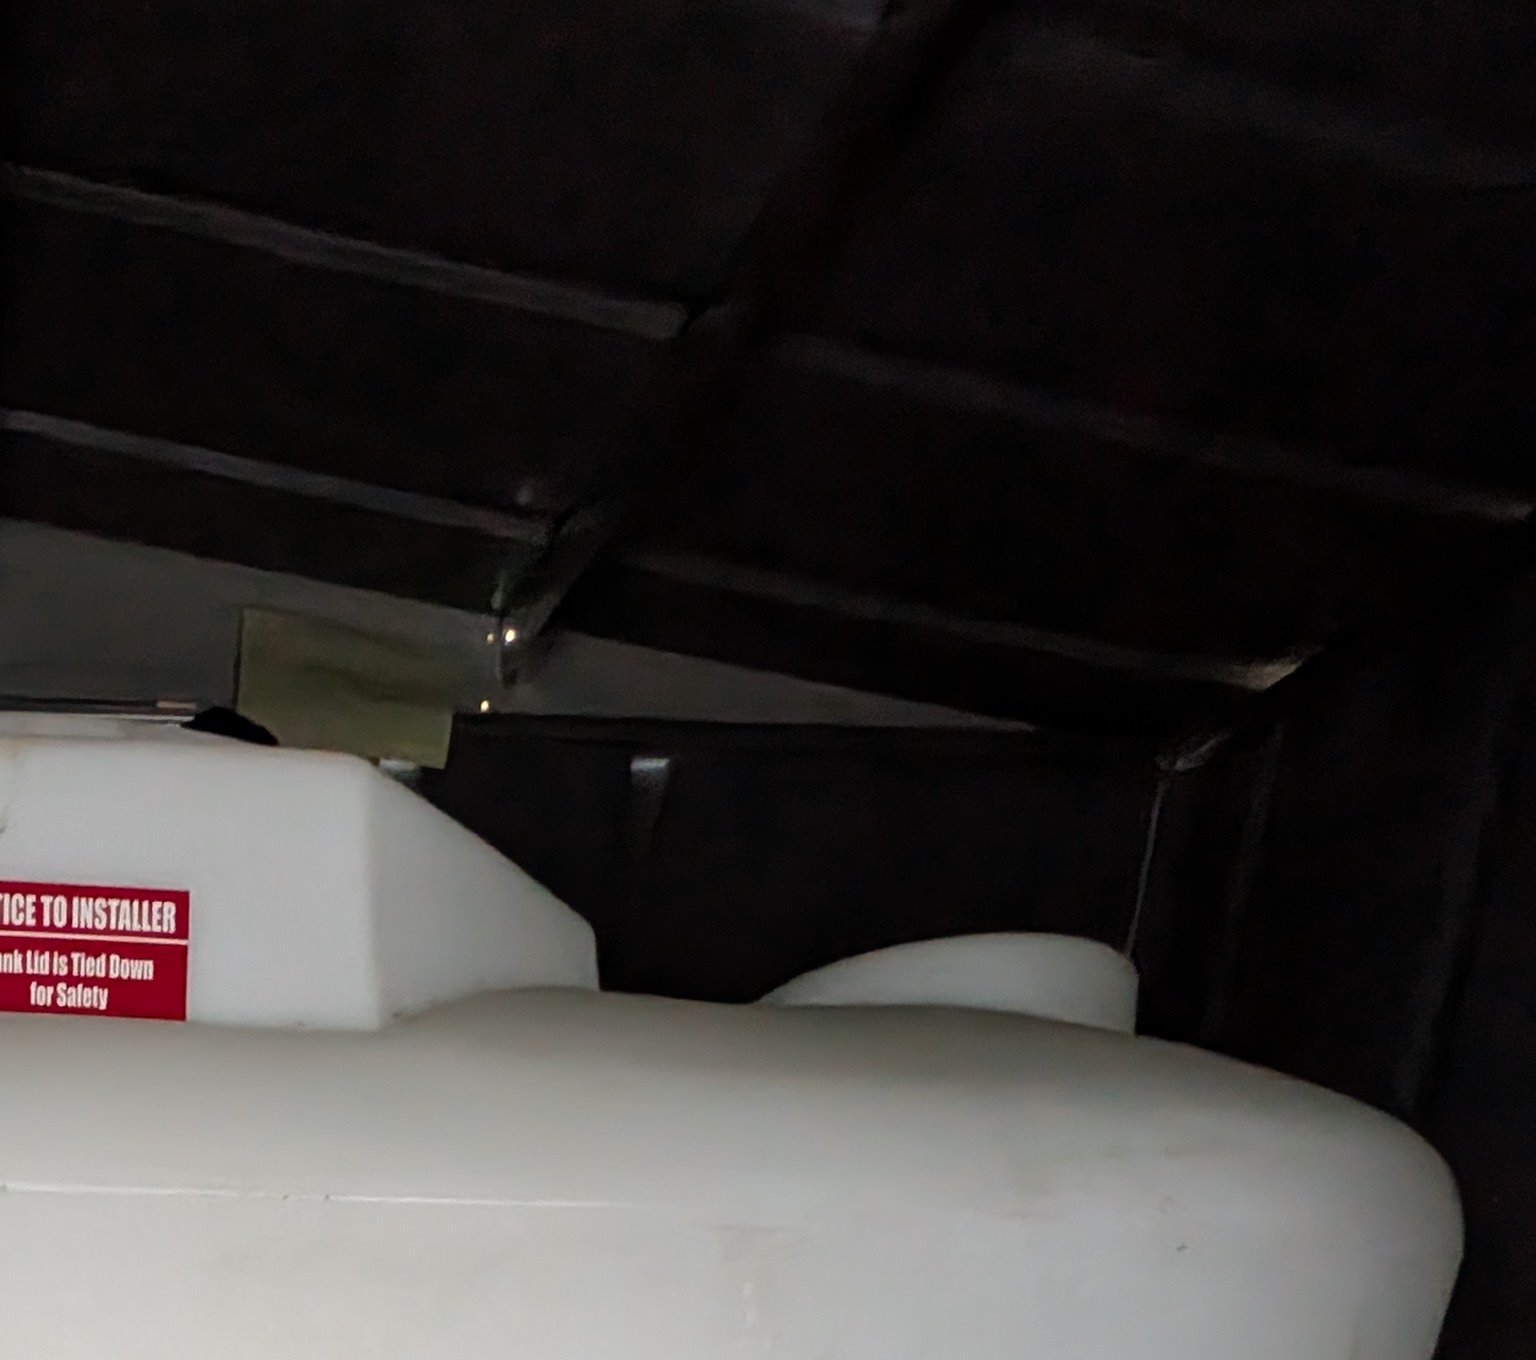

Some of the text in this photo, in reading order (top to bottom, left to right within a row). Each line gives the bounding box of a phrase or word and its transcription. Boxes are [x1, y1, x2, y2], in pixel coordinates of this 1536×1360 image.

[41, 895, 67, 928] TO
[71, 897, 176, 934] INSTALLER
[26, 950, 50, 975] Lid
[71, 952, 106, 978] Tied
[109, 954, 154, 980] Down
[30, 982, 109, 1010] for Safety
